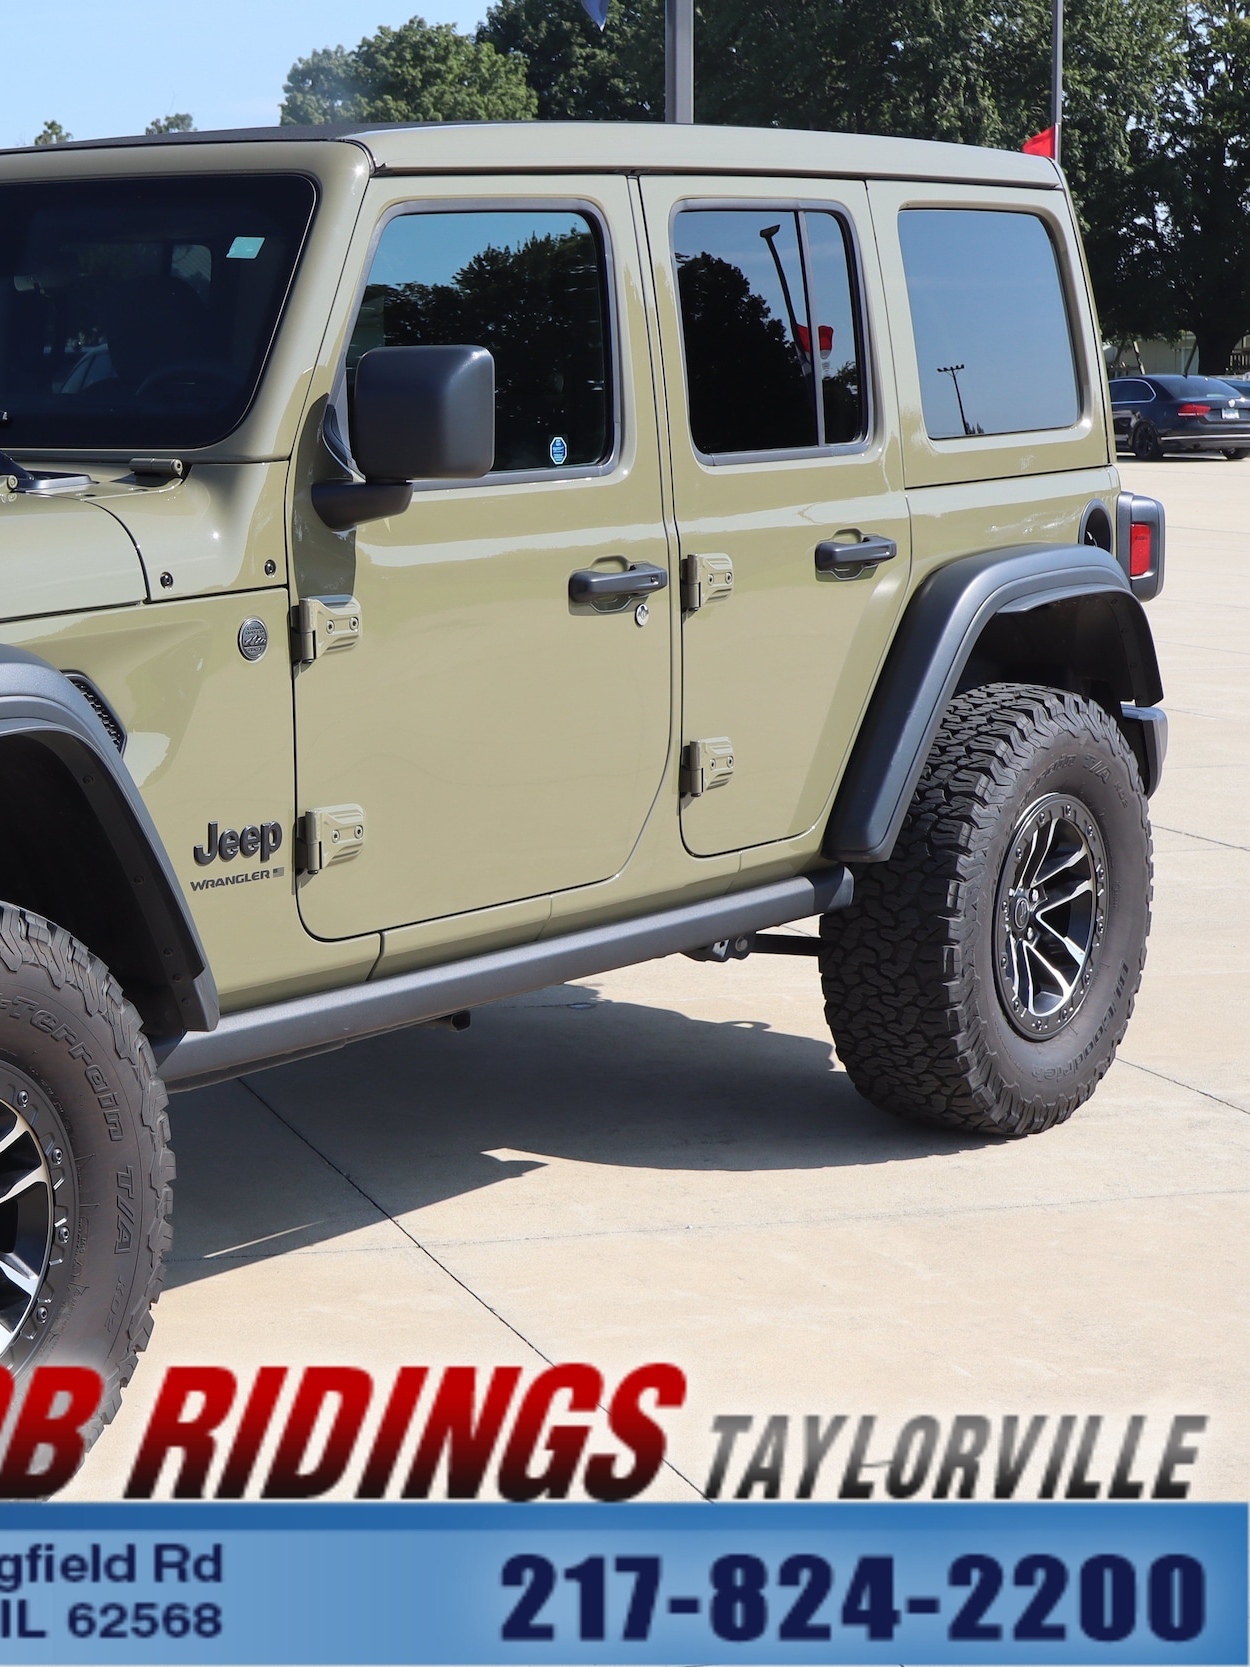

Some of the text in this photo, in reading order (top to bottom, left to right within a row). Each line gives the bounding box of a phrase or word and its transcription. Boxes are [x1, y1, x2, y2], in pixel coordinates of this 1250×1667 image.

[193, 821, 282, 866] Jeep
[190, 869, 270, 892] WRANGLER
[114, 1165, 135, 1254] T/A
